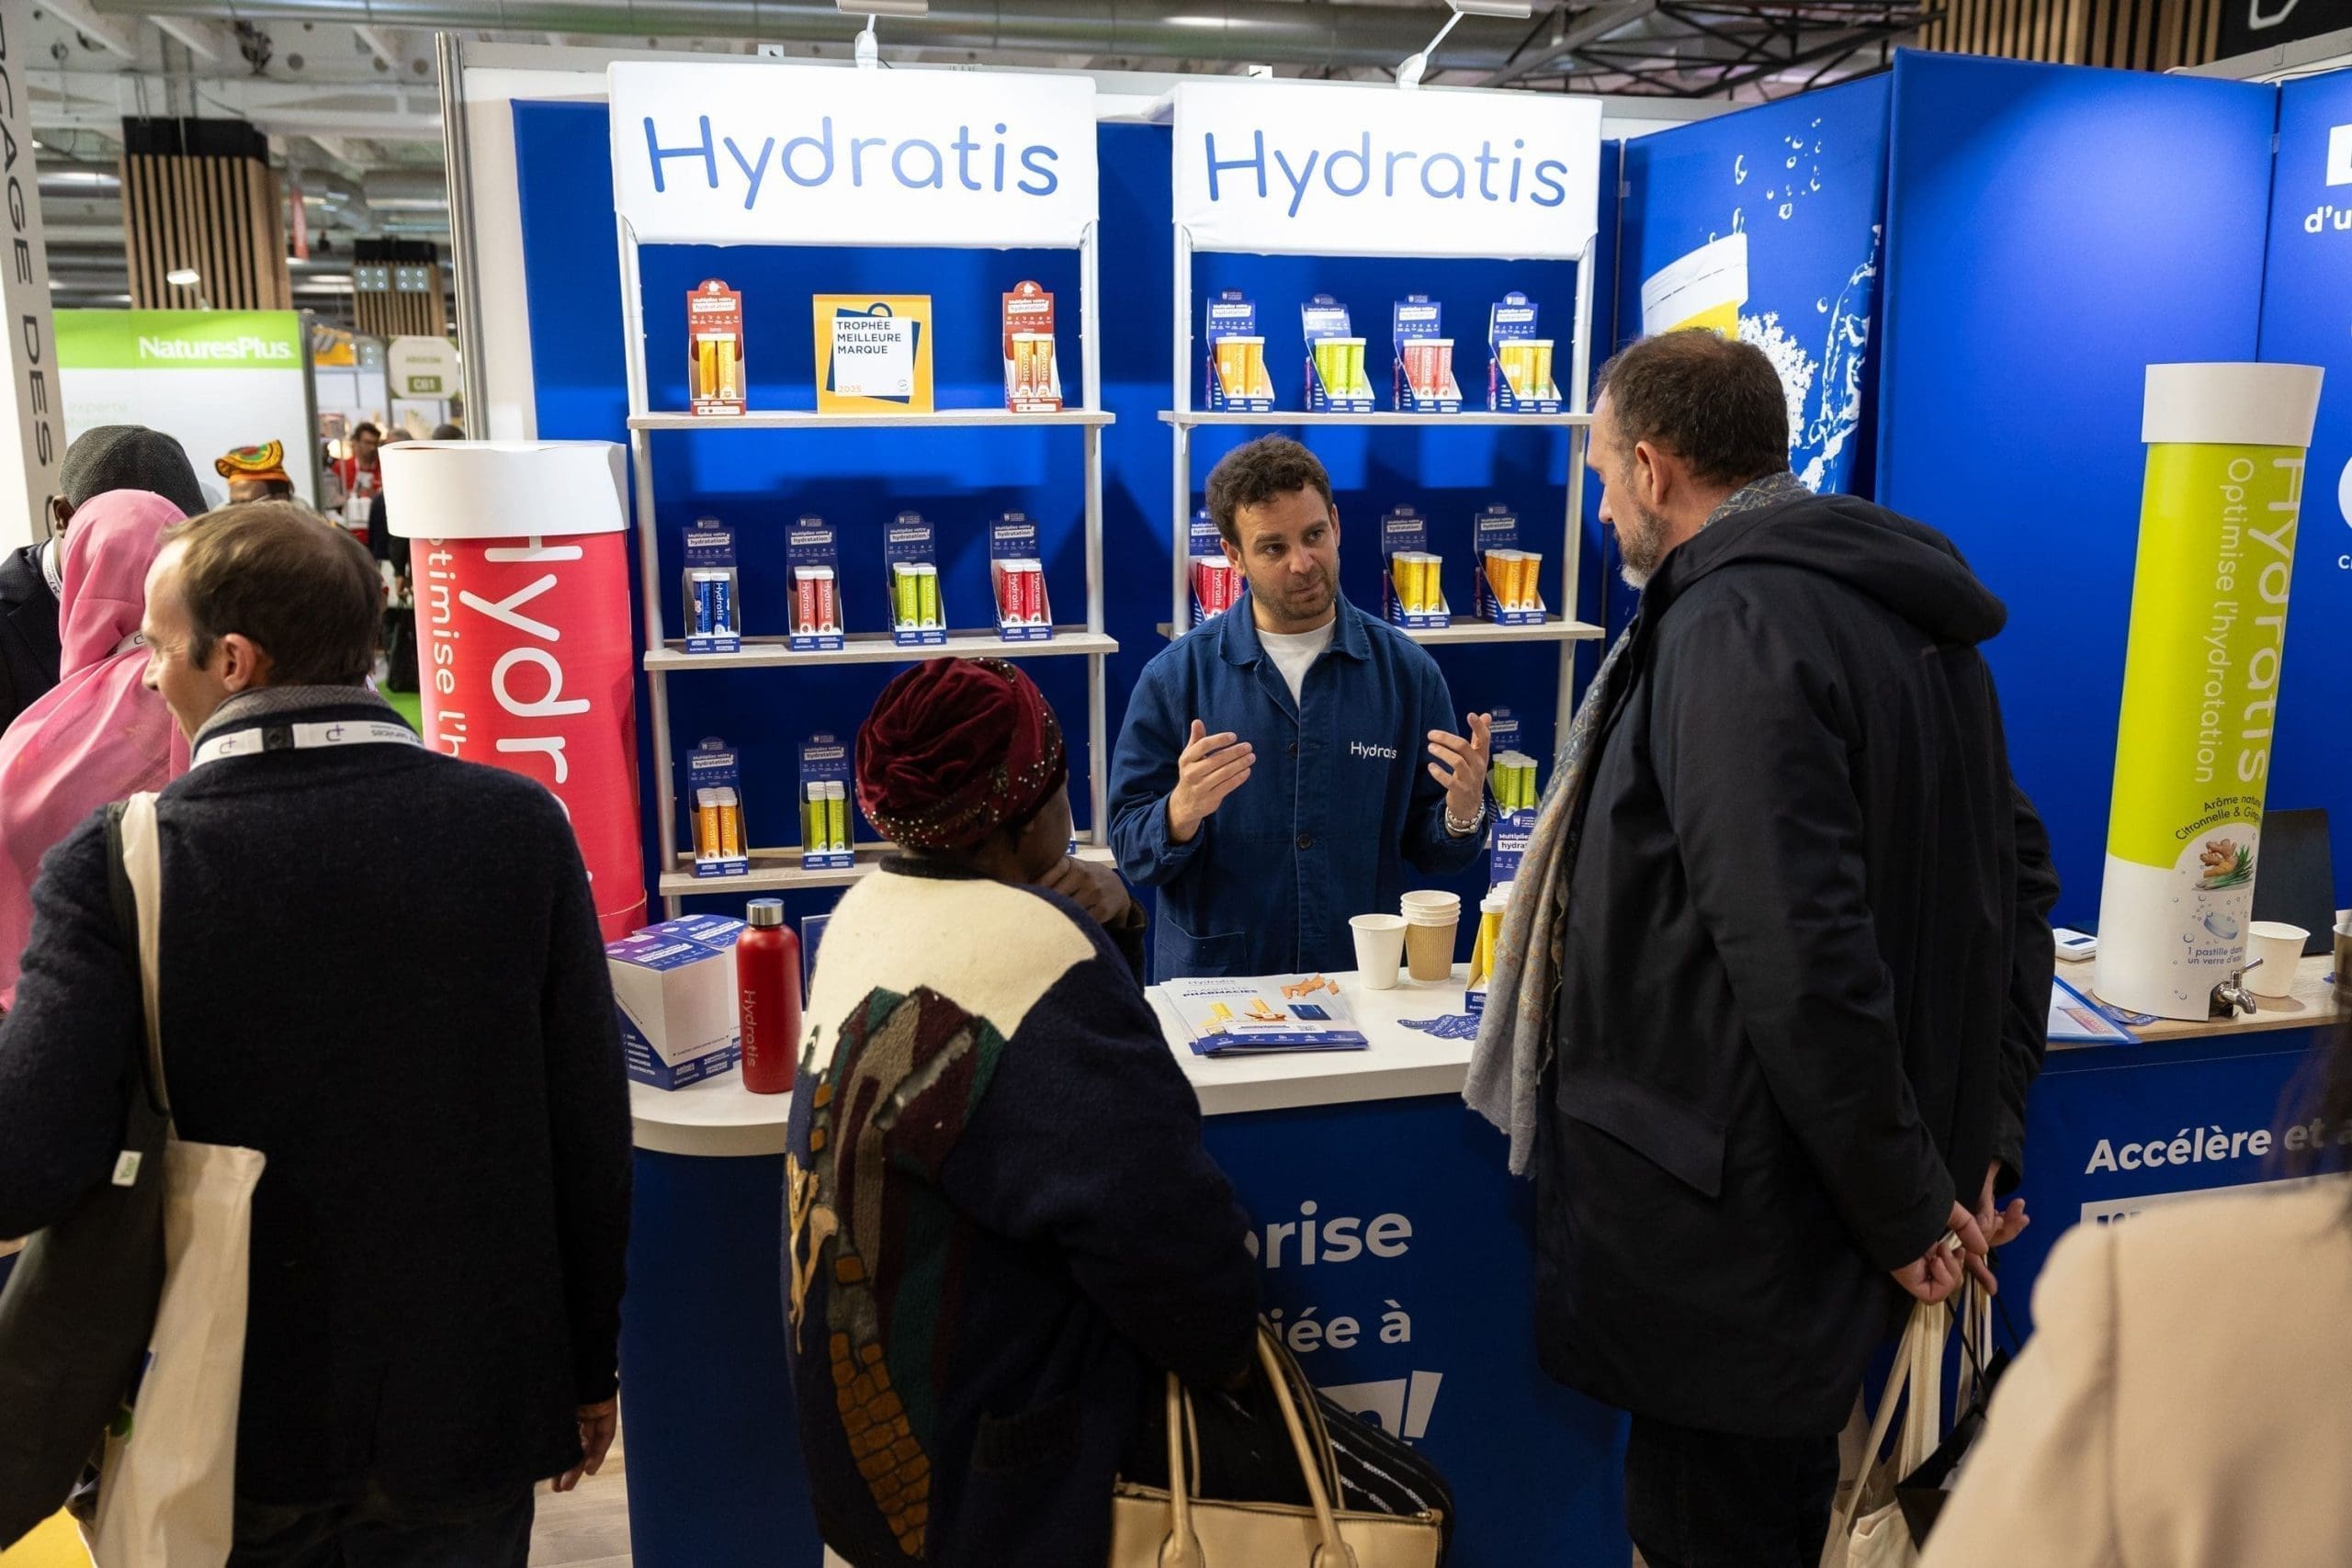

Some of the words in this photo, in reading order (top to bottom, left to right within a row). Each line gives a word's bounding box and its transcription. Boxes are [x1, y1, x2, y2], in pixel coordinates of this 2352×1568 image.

[643, 115, 1058, 210] Hydratis
[1204, 130, 1567, 218] Hydratis
[2304, 205, 2352, 233] d'u
[138, 336, 291, 359] NaturesPlus
[837, 319, 891, 331] TROPHÉE
[837, 333, 901, 343] MEILLEURE
[838, 345, 888, 355] MARQUE
[22, 315, 53, 467] DES
[2215, 457, 2256, 592] Optimise
[2237, 457, 2304, 783] Hydratis
[458, 536, 591, 822] Hydr
[2195, 601, 2239, 784] l'hydratation
[438, 710, 467, 758] l'h
[1351, 740, 1396, 760] Hydras
[2175, 809, 2231, 840] Citronnelle
[2233, 807, 2240, 818] &
[2204, 795, 2238, 812] Arôme
[2188, 946, 2192, 955] 1
[2196, 947, 2228, 957] pastille
[743, 990, 759, 1067] Hydratis
[2085, 1124, 2272, 1175] Accélère
[2284, 1118, 2326, 1151] et
[1244, 1200, 1412, 1269] rise
[1263, 1306, 1360, 1353] iée
[1379, 1299, 1410, 1344] à
